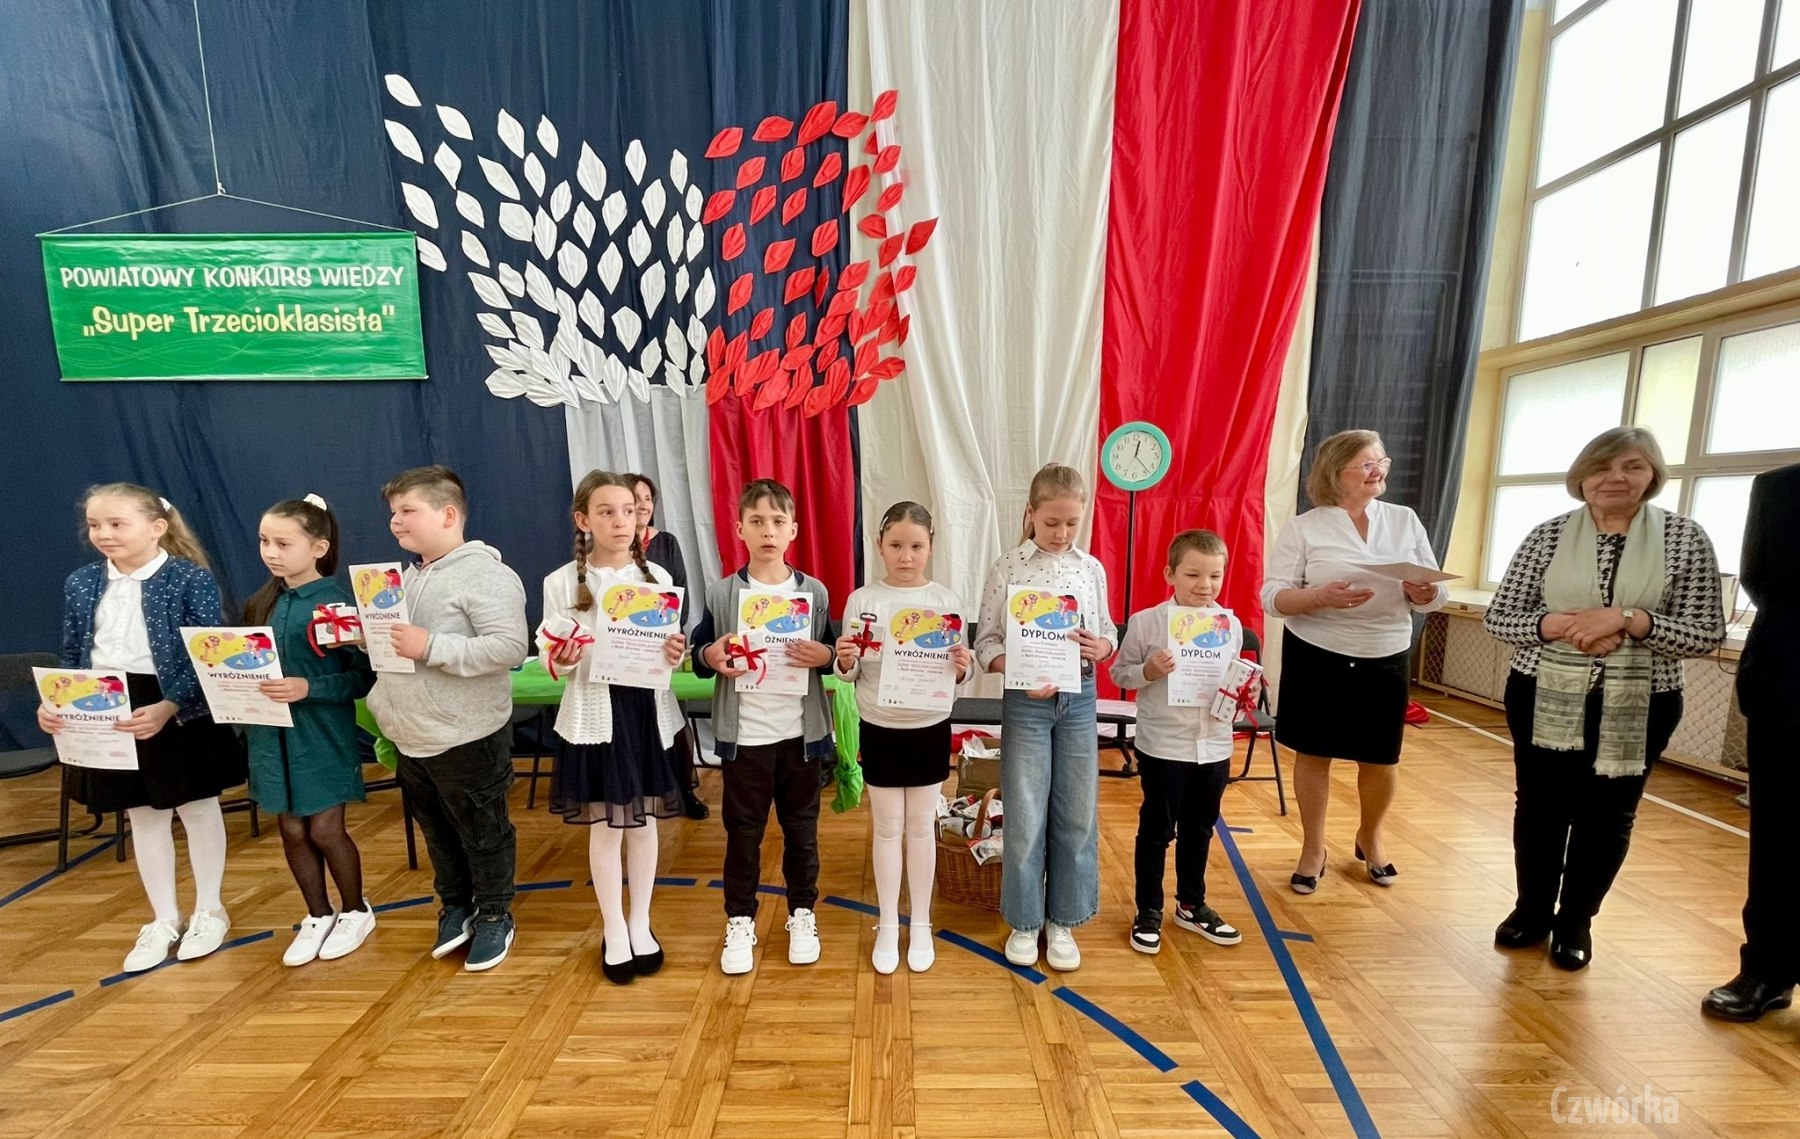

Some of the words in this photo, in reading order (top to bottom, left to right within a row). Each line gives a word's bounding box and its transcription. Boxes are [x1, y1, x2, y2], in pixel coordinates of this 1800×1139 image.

[60, 266, 195, 288] POWIATOWY
[204, 266, 312, 288] KONKURS
[318, 266, 405, 287] WIEDZY
[607, 626, 668, 640] WYRÓŻNIENIE
[1021, 628, 1066, 641] DYPLOM
[894, 649, 950, 661] WYRÓŻNIENIE
[1181, 648, 1221, 659] DYPLOM
[207, 671, 271, 680] WYRÓŻNIENIE
